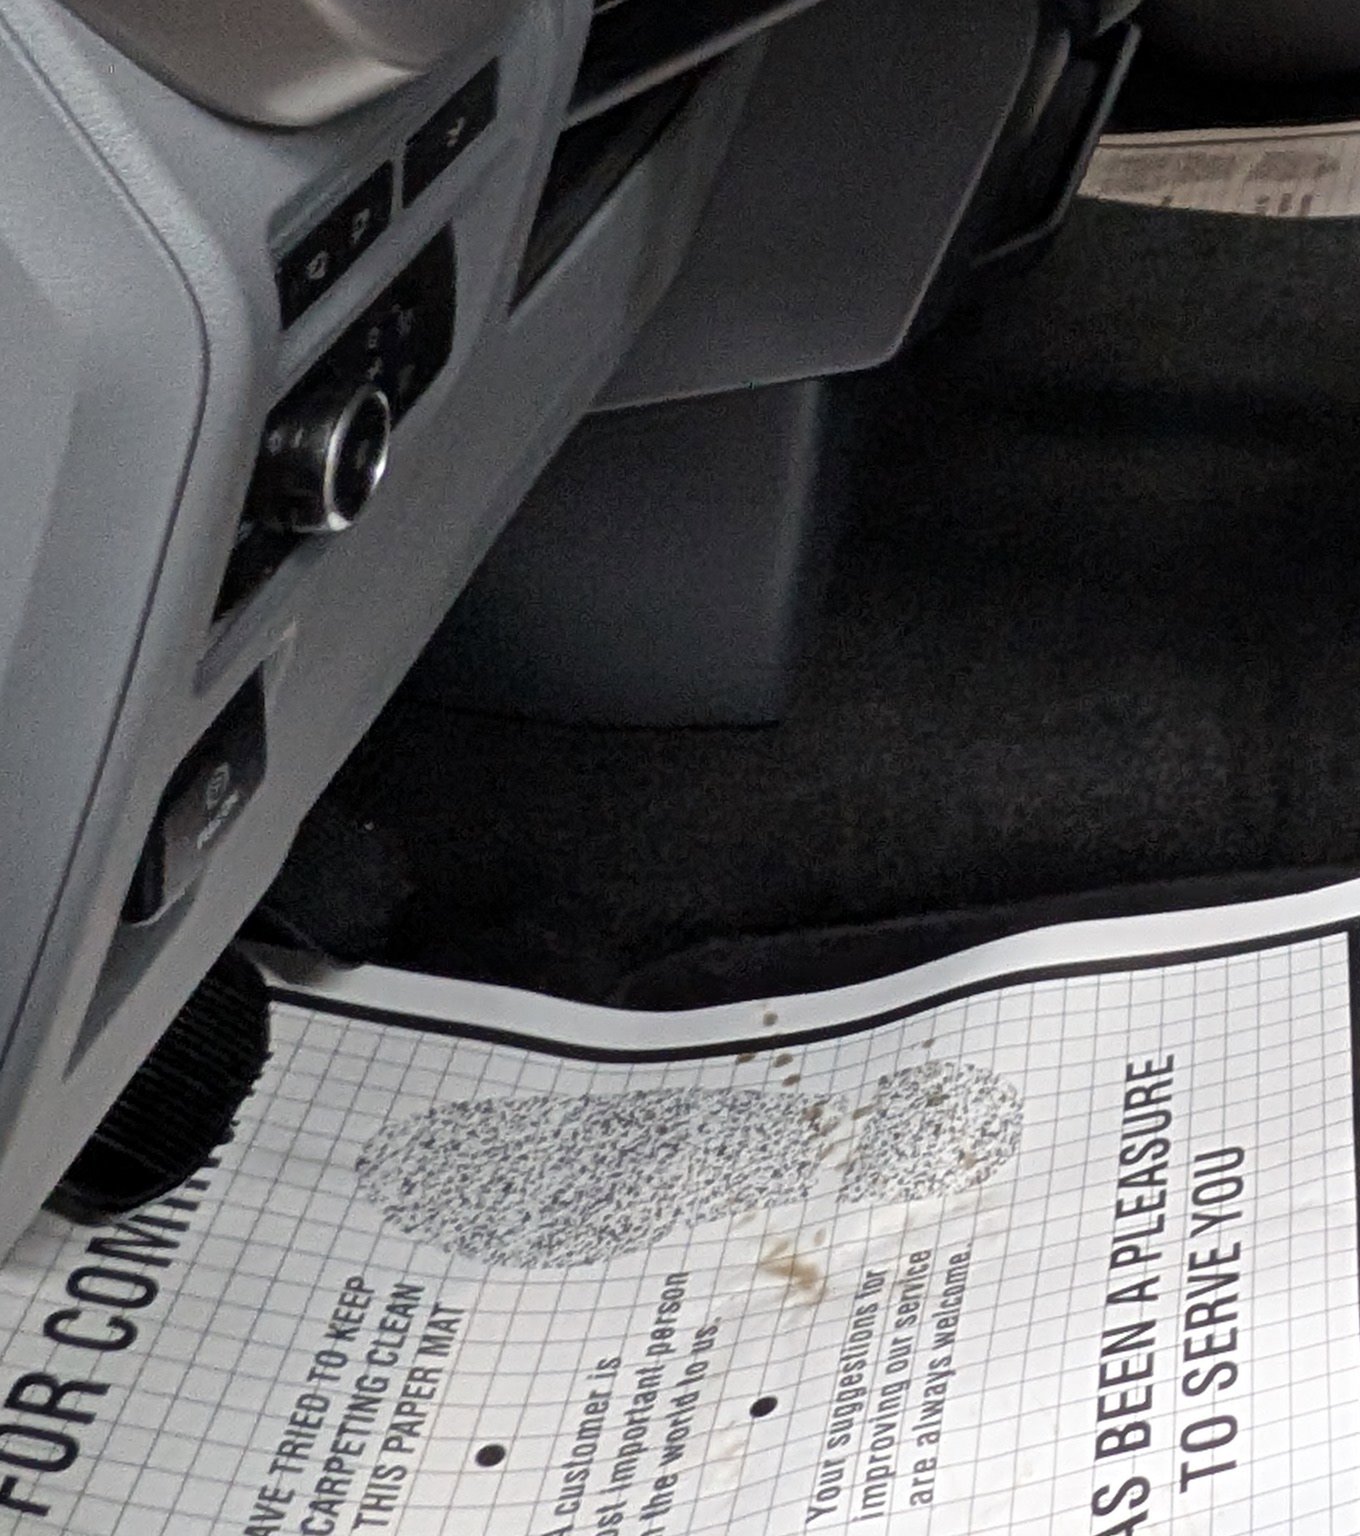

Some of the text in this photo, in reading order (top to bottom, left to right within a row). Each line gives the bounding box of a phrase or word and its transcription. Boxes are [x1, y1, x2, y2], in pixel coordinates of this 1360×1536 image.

[1109, 1053, 1175, 1271] PLEASURE
[307, 1350, 348, 1383] TO
[325, 1275, 375, 1341] KEEP
[691, 1316, 722, 1356] us.
[1106, 1275, 1160, 1307] A
[1179, 1146, 1246, 1494] TO SERVE YOU
[268, 1393, 330, 1475] TRIED
[301, 1282, 425, 1536] CARPETING CLEAN
[352, 1301, 465, 1530] THIS PAPER MAT
[554, 1390, 613, 1516] customer
[586, 1356, 622, 1381] is
[600, 1364, 666, 1494] important
[646, 1271, 689, 1356] person
[659, 1391, 700, 1468] world
[676, 1360, 709, 1387] to
[805, 1268, 888, 1524] Your suggestions for
[852, 1248, 932, 1523] improving our service
[909, 1242, 973, 1507] are always welcome.
[1094, 1319, 1157, 1461] BEEN
[639, 1472, 680, 1522] the
